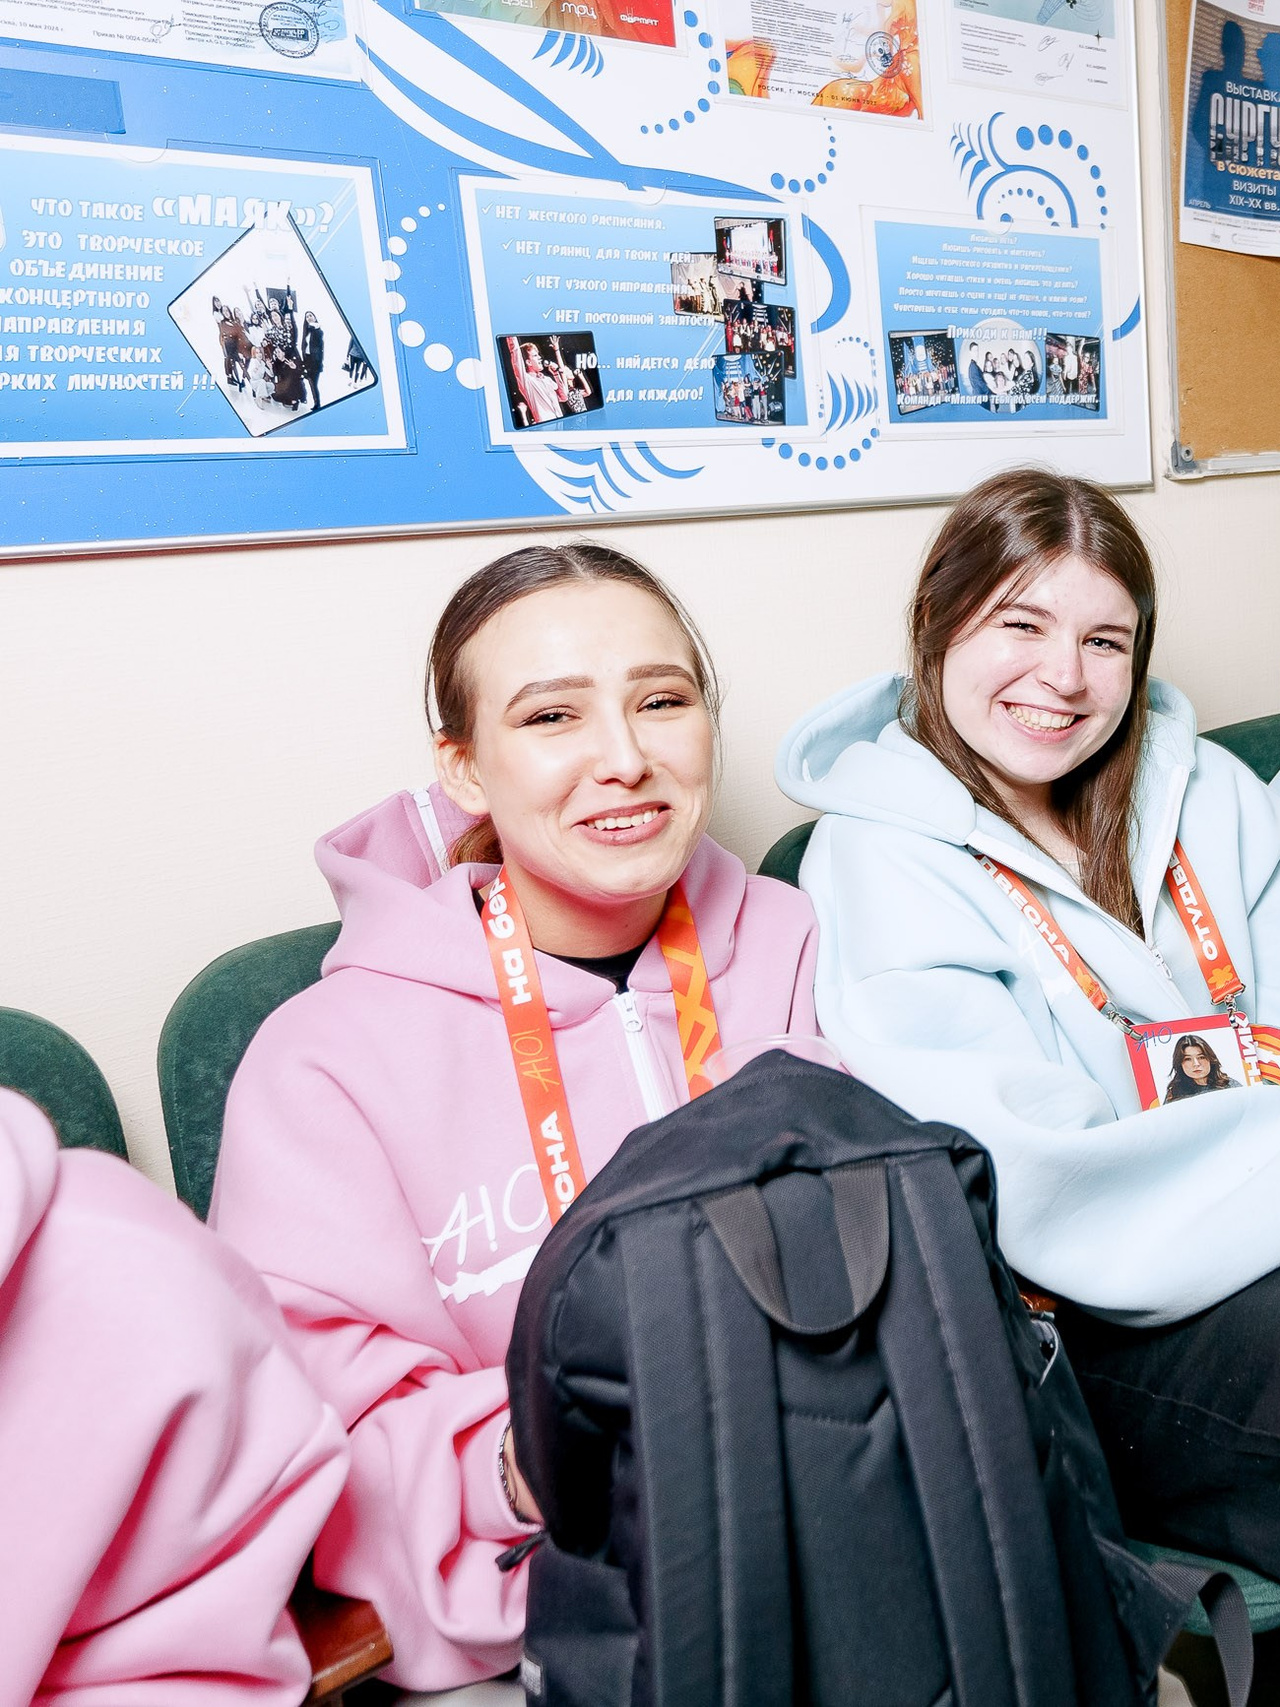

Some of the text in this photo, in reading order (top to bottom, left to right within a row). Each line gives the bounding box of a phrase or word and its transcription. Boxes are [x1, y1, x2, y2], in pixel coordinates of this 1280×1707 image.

[93, 30, 115, 39] Приказ
[757, 84, 787, 95] РОССИЯ,
[797, 89, 824, 100] МОСКВА
[1217, 161, 1225, 172] в
[1233, 180, 1277, 196] ВИЗИТЫ
[31, 194, 335, 233] ЧТО ТАКОЕ «МАЯК»?
[1189, 199, 1211, 210] АПРЕЛЬ
[1264, 202, 1280, 212] вв.
[496, 205, 666, 230] НЕТ ЖЕСТКОГО РАСПИСАНИЯ.
[22, 230, 205, 257] ЭТО ТВОРЧЕСКОЕ
[516, 240, 695, 264] НЕТ ГРАНИЦ ДЛЯ ТВОИХ ИДЕЙ.
[536, 275, 560, 289] НЕТ
[565, 278, 607, 291] УЗКОГО
[0, 287, 150, 311] КОНЦЕРТНОГО
[0, 316, 146, 336] АПРАВЛЕНИЯ
[556, 309, 580, 323] НЕТ
[585, 312, 654, 326] ПОСТОЯННОЙ
[27, 345, 163, 364] ТВОРЧЕСКИХ
[576, 353, 717, 372] НО... НАЙДЕТСЯ ДЕЛО
[67, 371, 184, 392] ЛИЧНОСТЕЙ
[192, 374, 217, 391] !!!
[605, 386, 704, 404] ДЛЯ КАЖДОГО!
